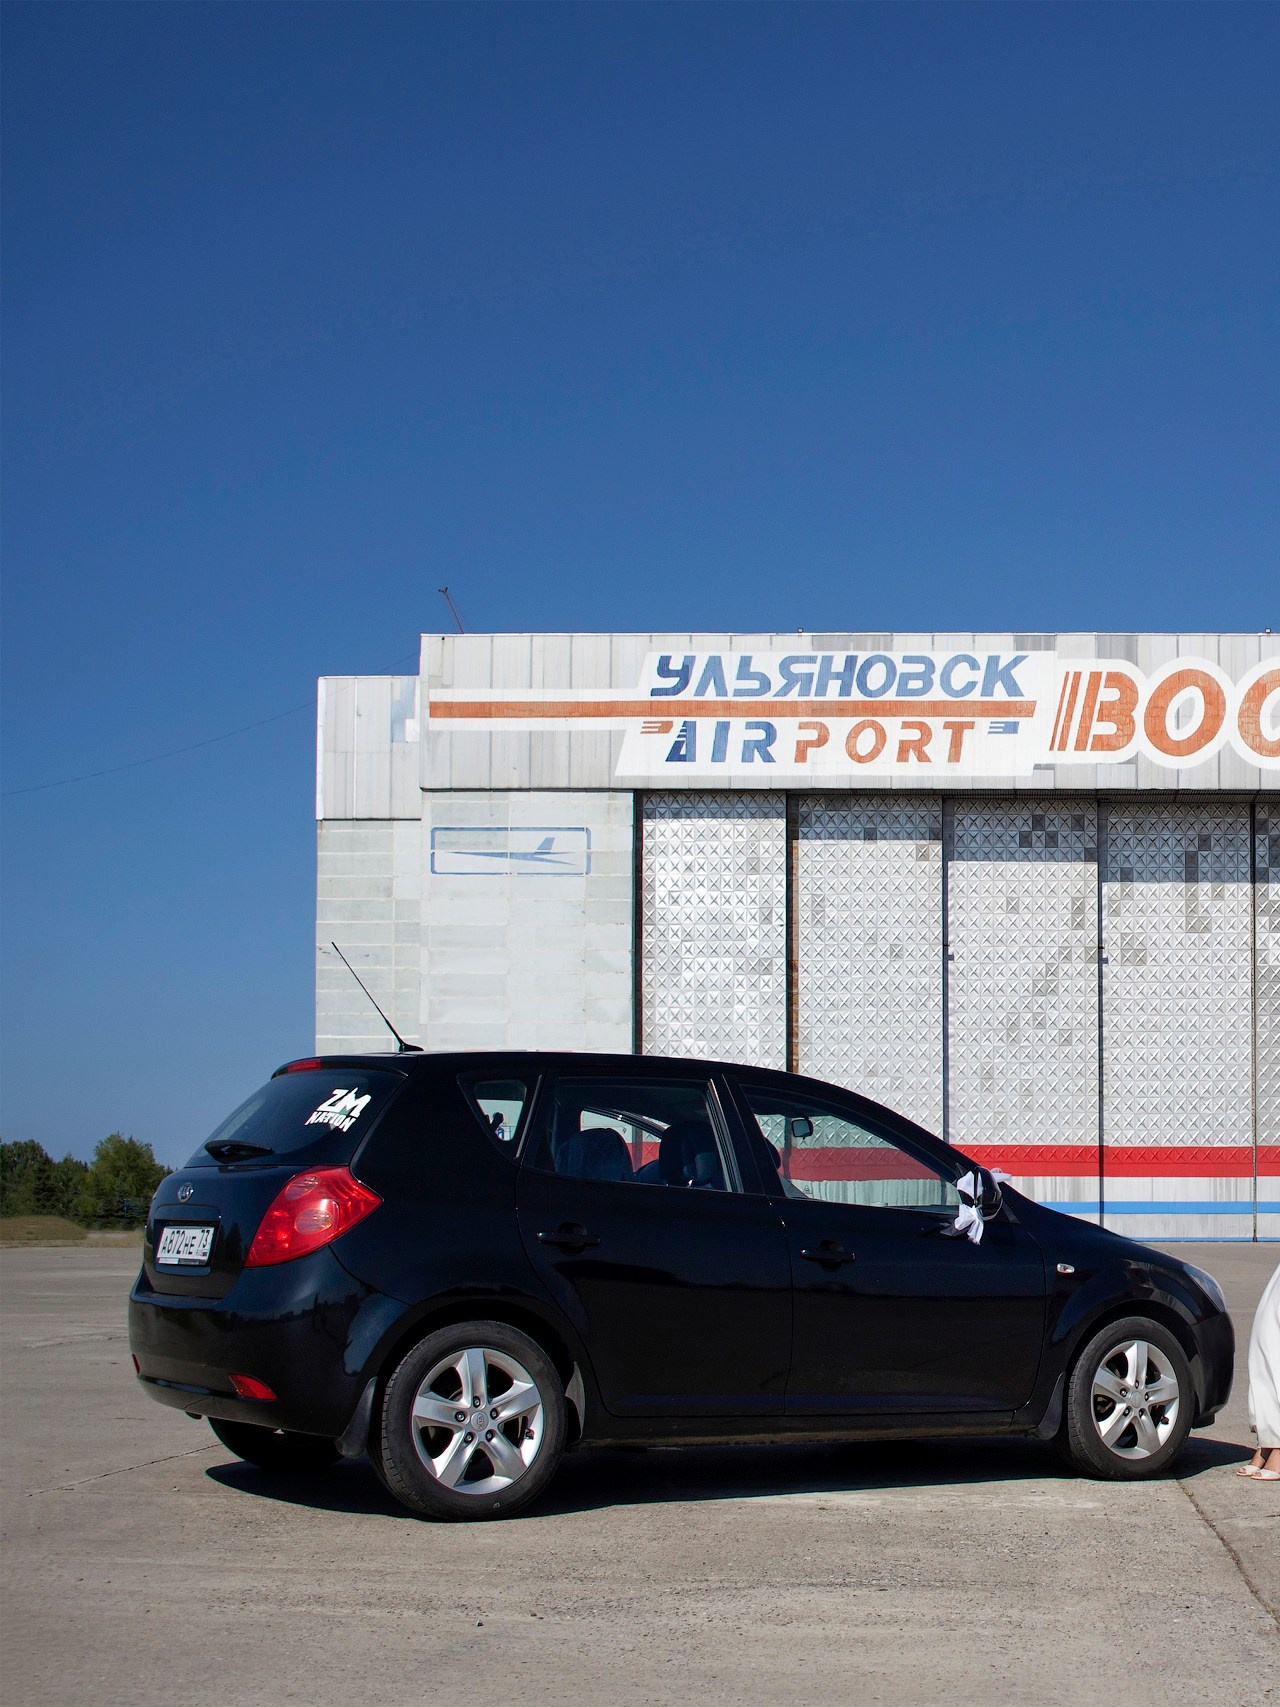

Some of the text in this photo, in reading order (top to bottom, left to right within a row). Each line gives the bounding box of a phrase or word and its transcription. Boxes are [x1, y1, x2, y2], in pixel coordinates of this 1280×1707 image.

[651, 653, 1029, 698] УЛЬЯНОВСК
[665, 719, 975, 763] AIRPORT
[304, 1111, 357, 1132] NATION
